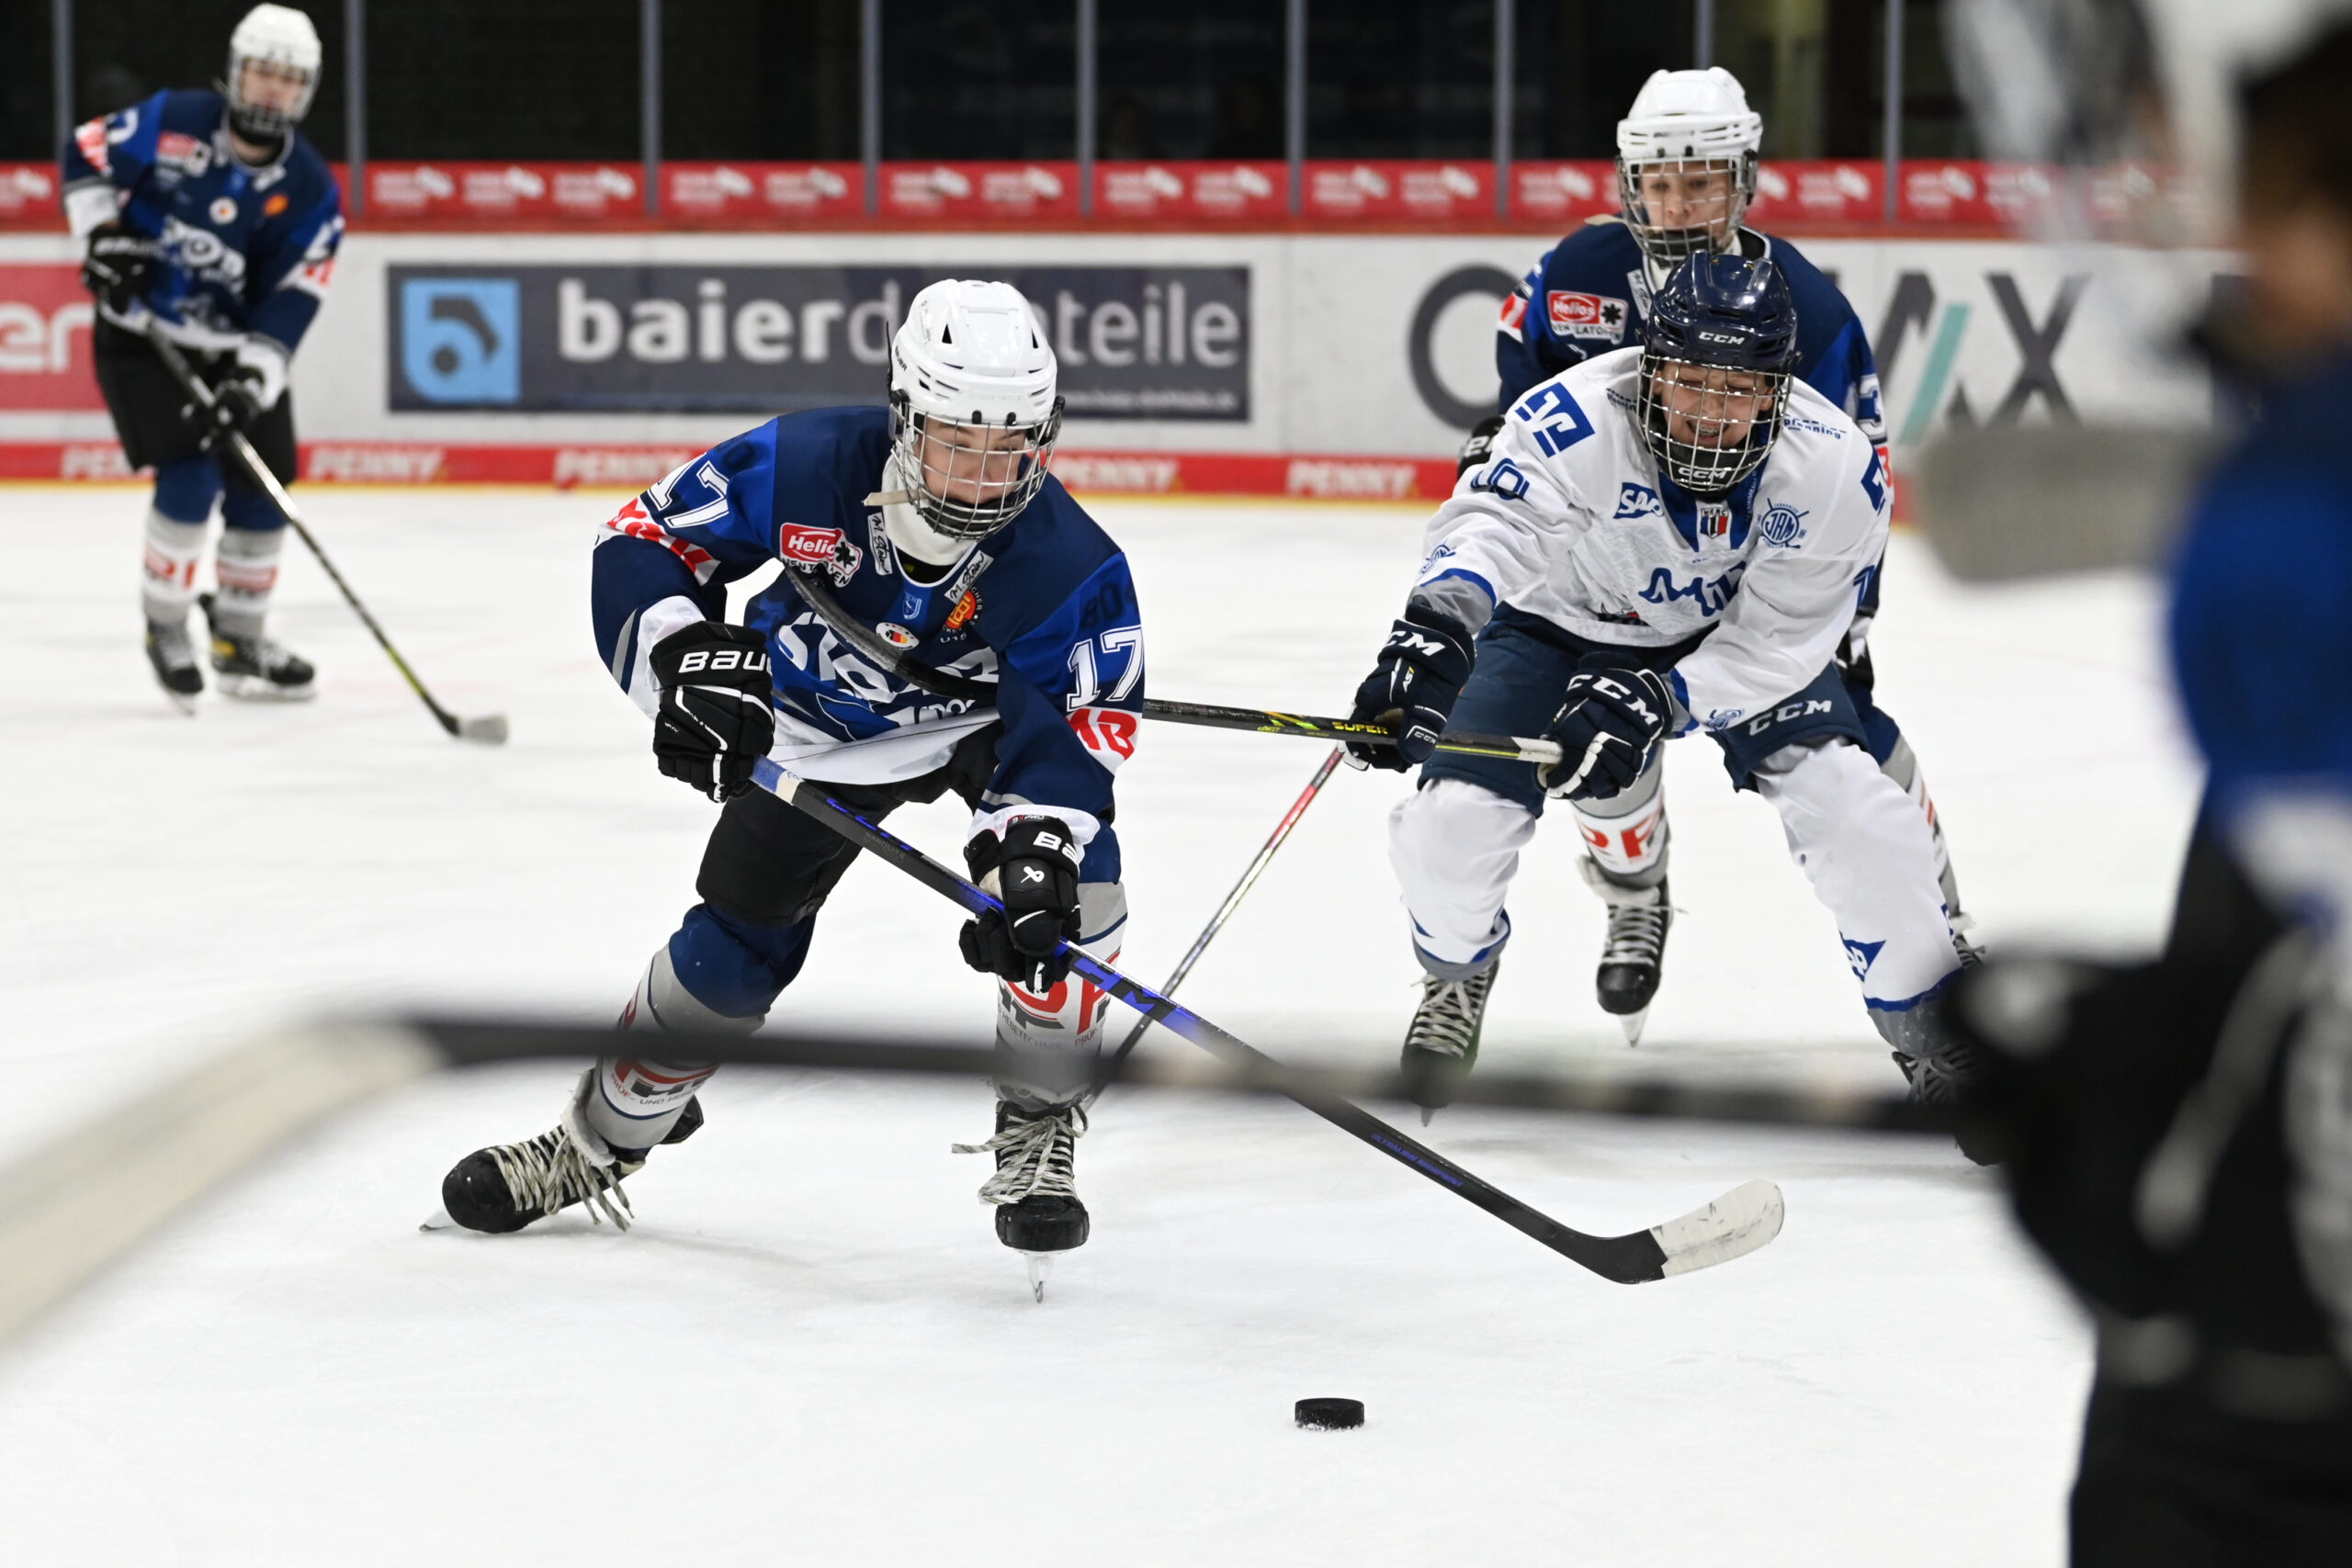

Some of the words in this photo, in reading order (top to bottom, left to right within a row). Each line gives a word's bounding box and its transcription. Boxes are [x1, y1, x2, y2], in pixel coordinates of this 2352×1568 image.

[559, 278, 1240, 366] baierdteile
[1698, 331, 1746, 345] CCM
[307, 446, 447, 481] PENNY
[1052, 458, 1181, 494] PENNY
[1288, 460, 1416, 498] PENNY
[1678, 466, 1728, 479] CCM
[1765, 512, 1796, 542] JAM
[787, 535, 836, 555] Helio
[1385, 630, 1447, 657] CM
[678, 650, 774, 675] BAU
[1066, 624, 1145, 713] 17
[1566, 674, 1659, 727] CCM
[1331, 721, 1389, 735] SUPER
[1748, 699, 1833, 737] CCM
